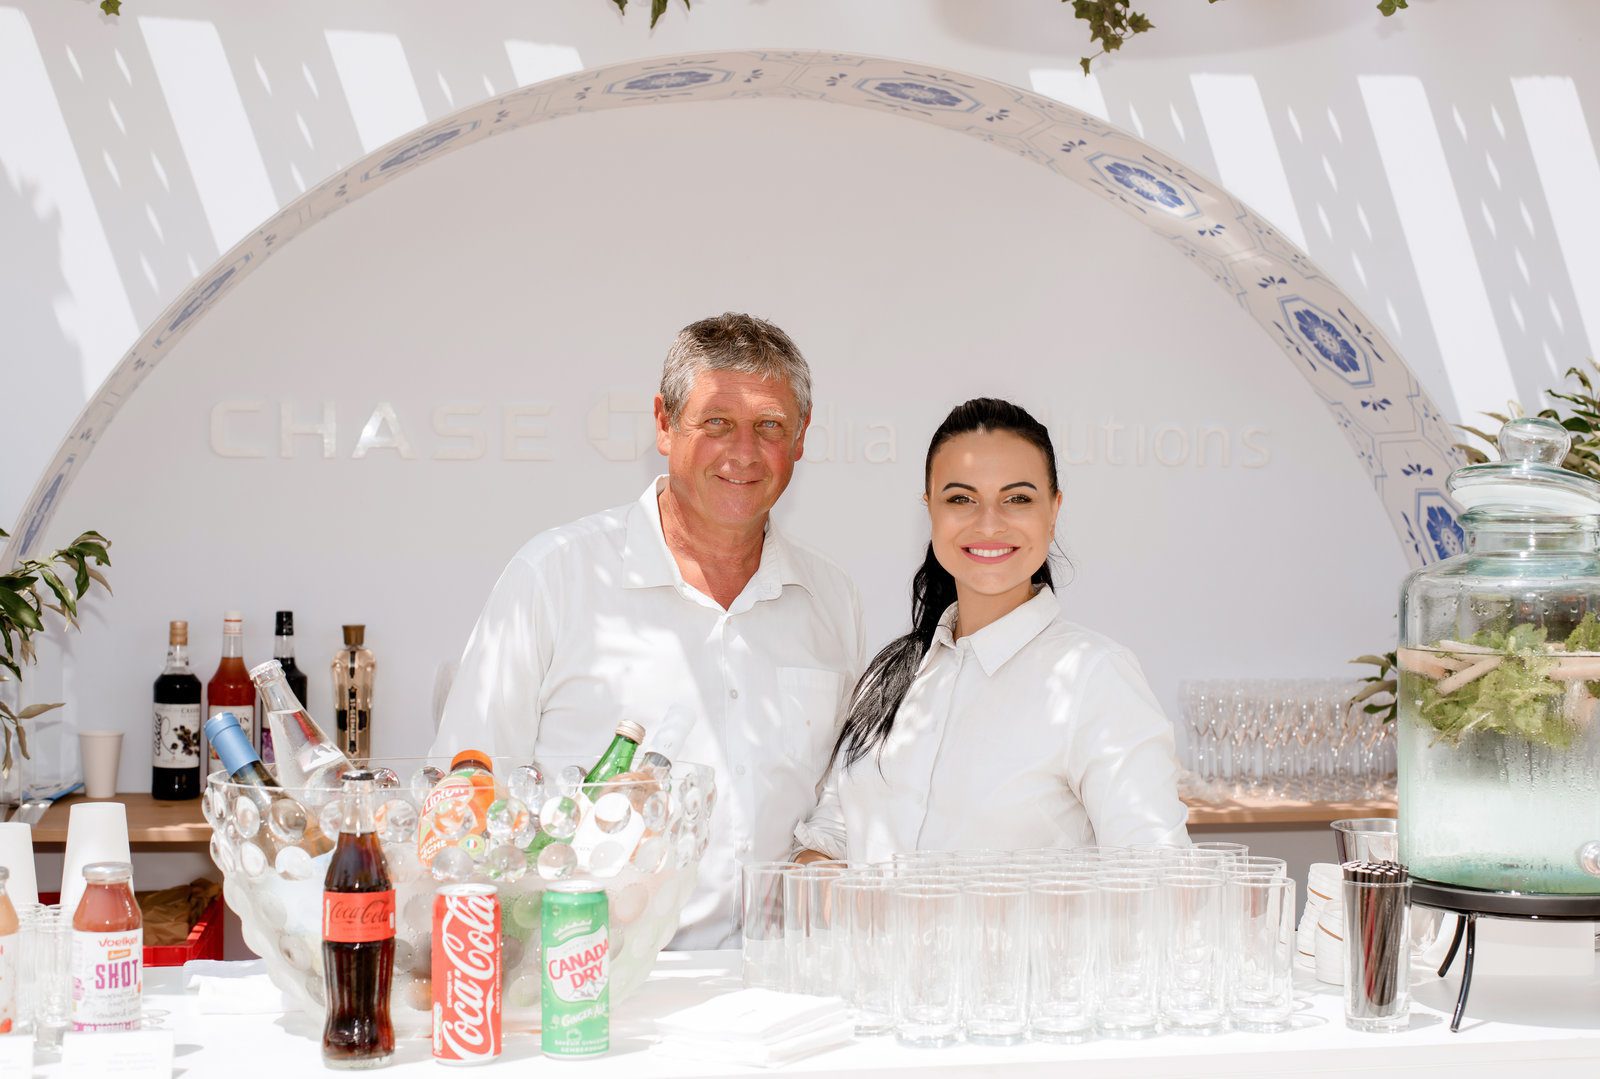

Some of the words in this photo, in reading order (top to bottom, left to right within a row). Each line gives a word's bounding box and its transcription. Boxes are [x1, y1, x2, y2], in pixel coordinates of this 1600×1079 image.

[209, 400, 556, 462] CHASE
[803, 400, 897, 465] dia
[330, 898, 390, 925] Coca-Cola
[95, 959, 139, 990] SHOT
[548, 938, 609, 980] CANADA
[570, 960, 604, 989] DRY
[442, 895, 496, 1060] Coca-Cola
